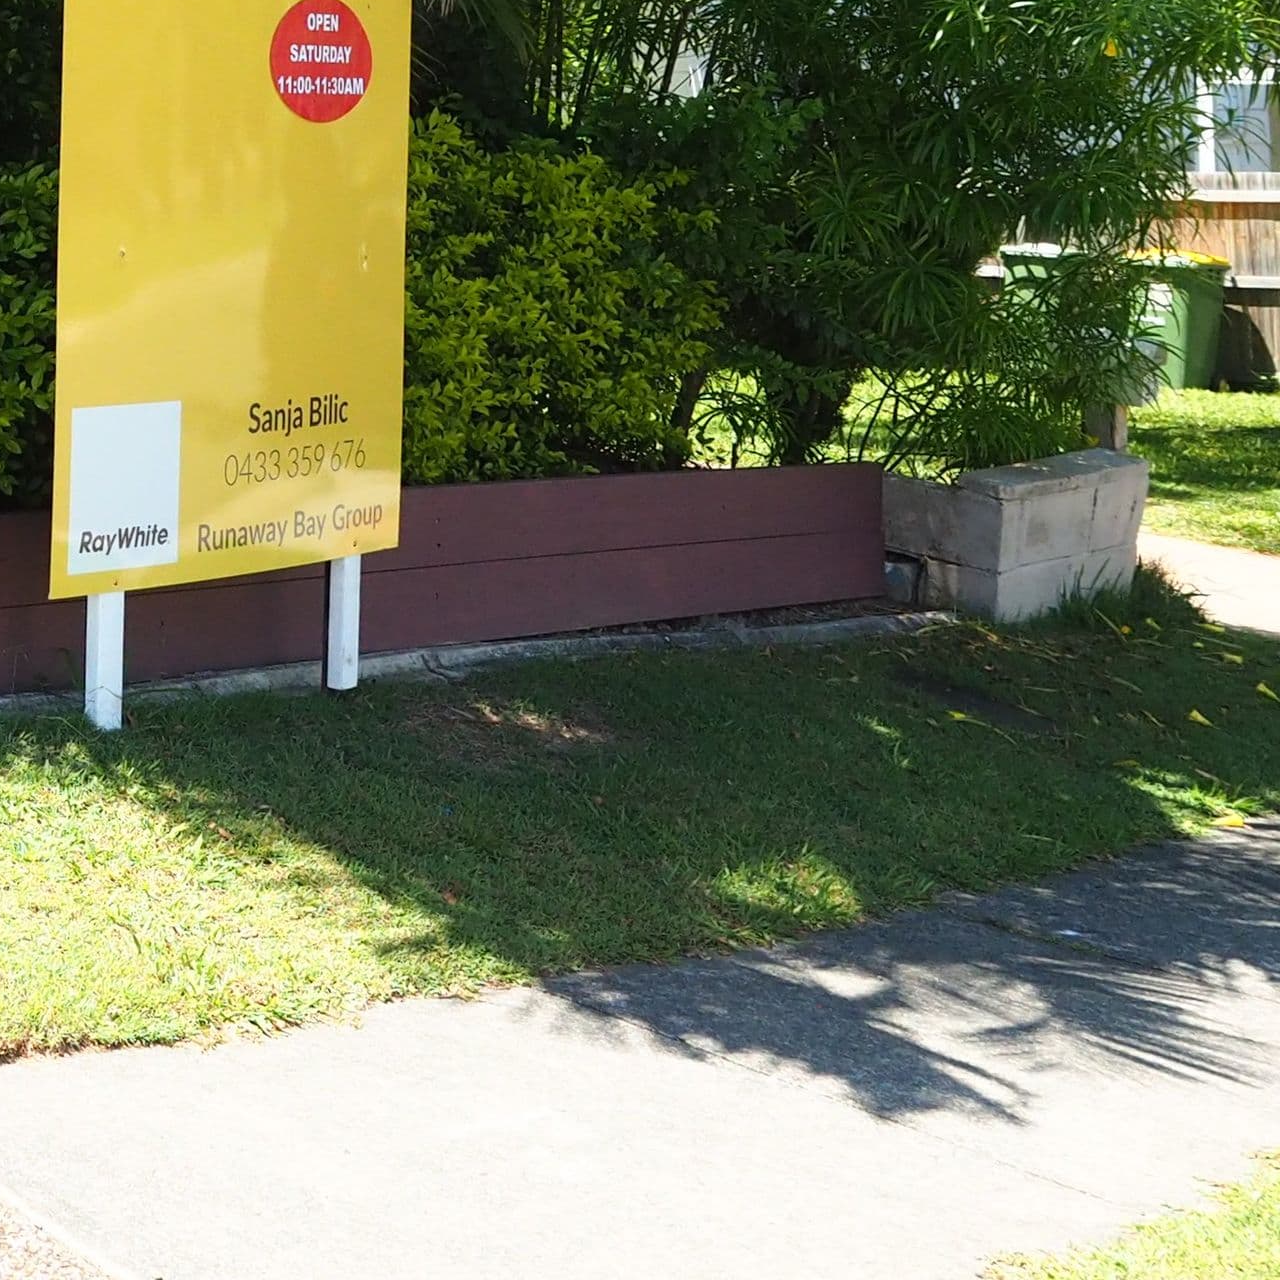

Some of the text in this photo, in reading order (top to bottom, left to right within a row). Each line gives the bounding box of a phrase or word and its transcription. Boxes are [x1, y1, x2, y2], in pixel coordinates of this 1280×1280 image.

[307, 12, 339, 32] OPEN
[290, 44, 352, 64] SATURDAY
[278, 75, 364, 95] 11:00-11:30AM
[248, 394, 349, 437] Sanja Bilic
[224, 438, 366, 486] 0433 359 676
[197, 504, 383, 552] Runaway Bay Group
